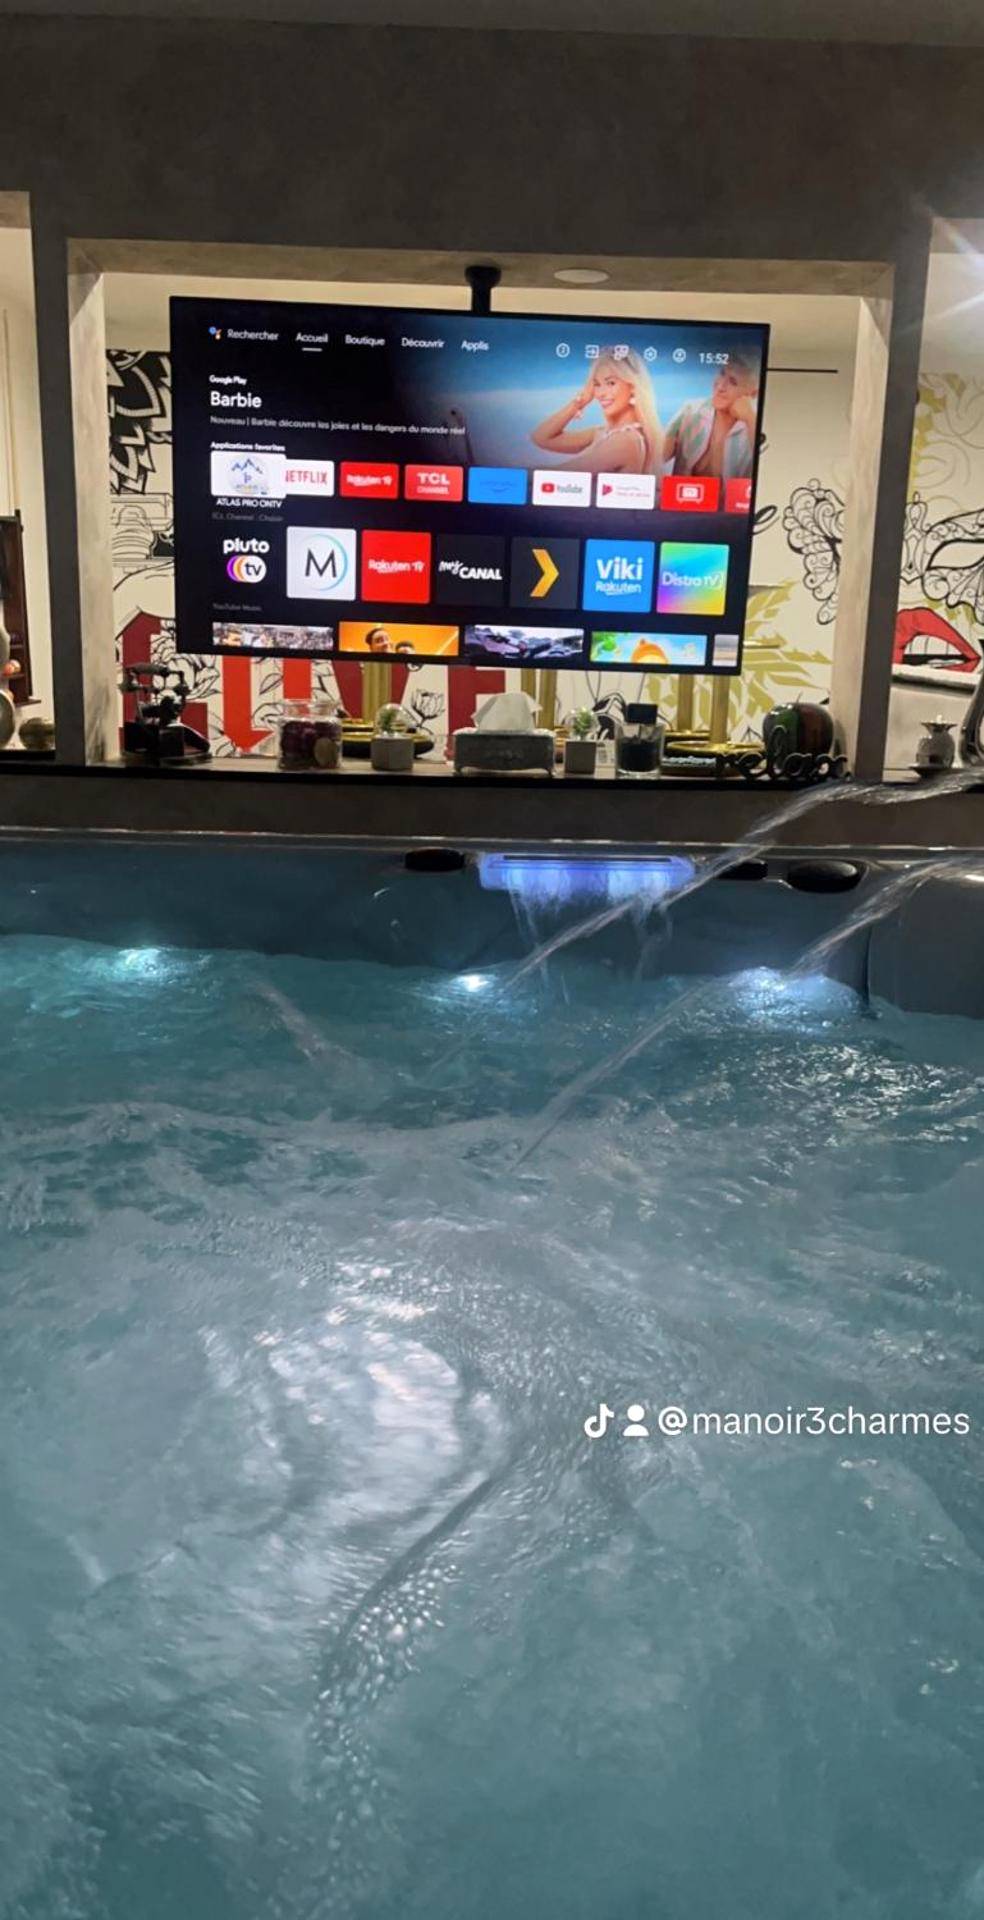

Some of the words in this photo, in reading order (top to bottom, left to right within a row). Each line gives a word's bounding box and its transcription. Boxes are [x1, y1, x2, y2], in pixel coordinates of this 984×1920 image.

[227, 329, 279, 341] Rechercher
[296, 332, 328, 343] Accueil
[345, 335, 385, 346] Boutique
[401, 337, 445, 348] Découvrir
[461, 340, 489, 351] Applis
[699, 353, 729, 364] 15:52
[209, 374, 232, 385] Google
[233, 375, 247, 385] Play
[210, 391, 262, 408] Barbie
[210, 416, 246, 425] Nouveau
[251, 418, 276, 426] Barbie
[278, 420, 316, 428] découvre
[317, 421, 329, 429] les
[351, 422, 360, 430] et
[361, 423, 373, 431] les
[374, 424, 406, 433] dangers
[420, 426, 448, 434] monde
[210, 441, 253, 450] Applications
[254, 443, 285, 451] favorites
[417, 472, 450, 485] TCL
[216, 498, 241, 507] ATLAS
[242, 499, 258, 507] PRO
[223, 538, 270, 554] pluto
[245, 561, 263, 576] tv
[305, 549, 337, 578] M
[368, 559, 411, 574] Rakuten
[597, 556, 644, 580] Viki
[661, 571, 702, 586] Distro
[595, 580, 642, 596] Rakuten
